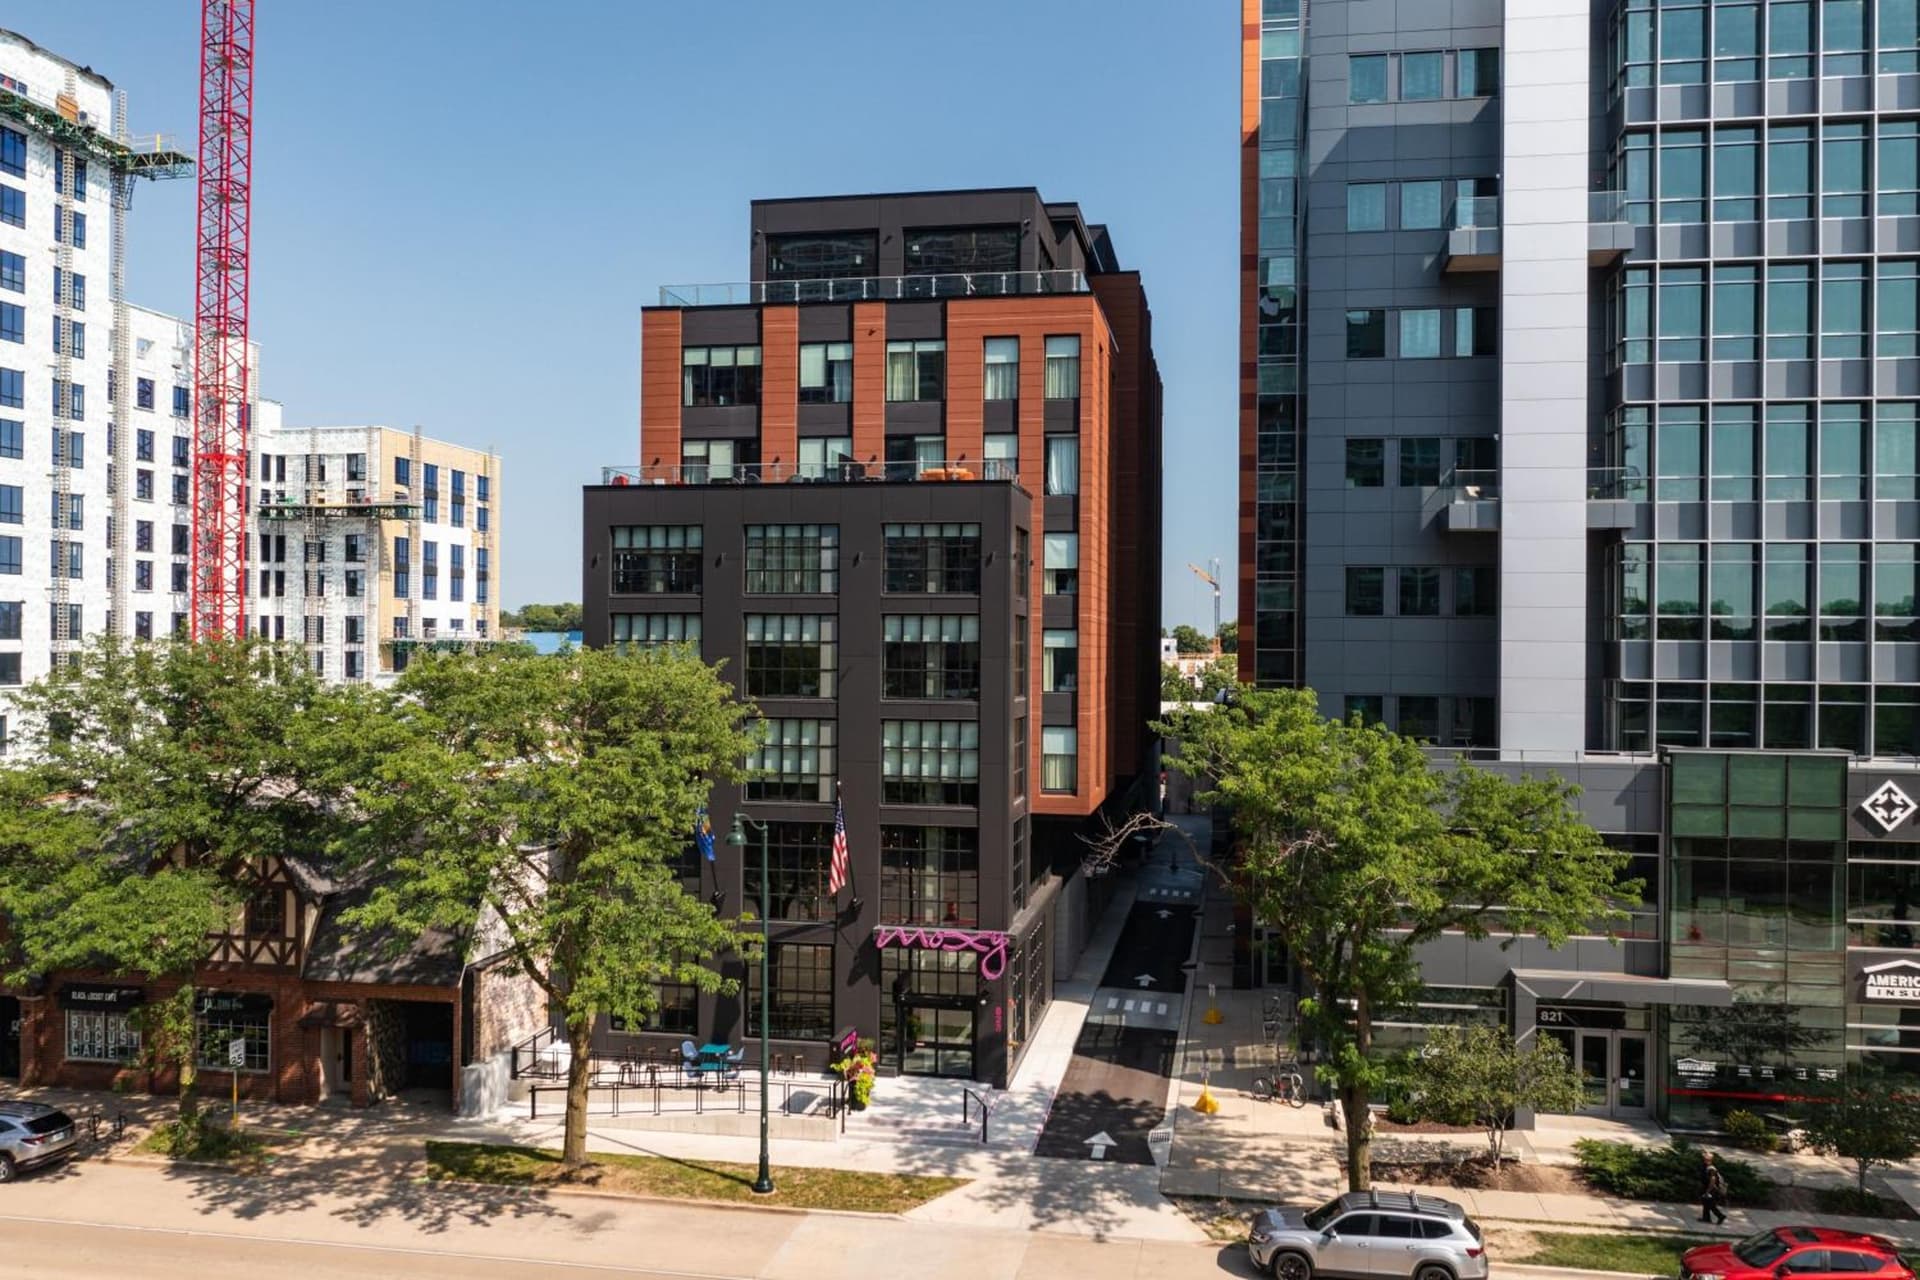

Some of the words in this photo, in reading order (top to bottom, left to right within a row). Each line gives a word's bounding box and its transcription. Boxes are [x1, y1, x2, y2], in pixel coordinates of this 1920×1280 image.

[1867, 974, 1920, 988] AMERIC
[71, 1014, 127, 1033] BLACK
[1540, 1010, 1562, 1022] 821
[71, 1029, 138, 1046] LOCUST
[71, 1043, 115, 1058] CAFE
